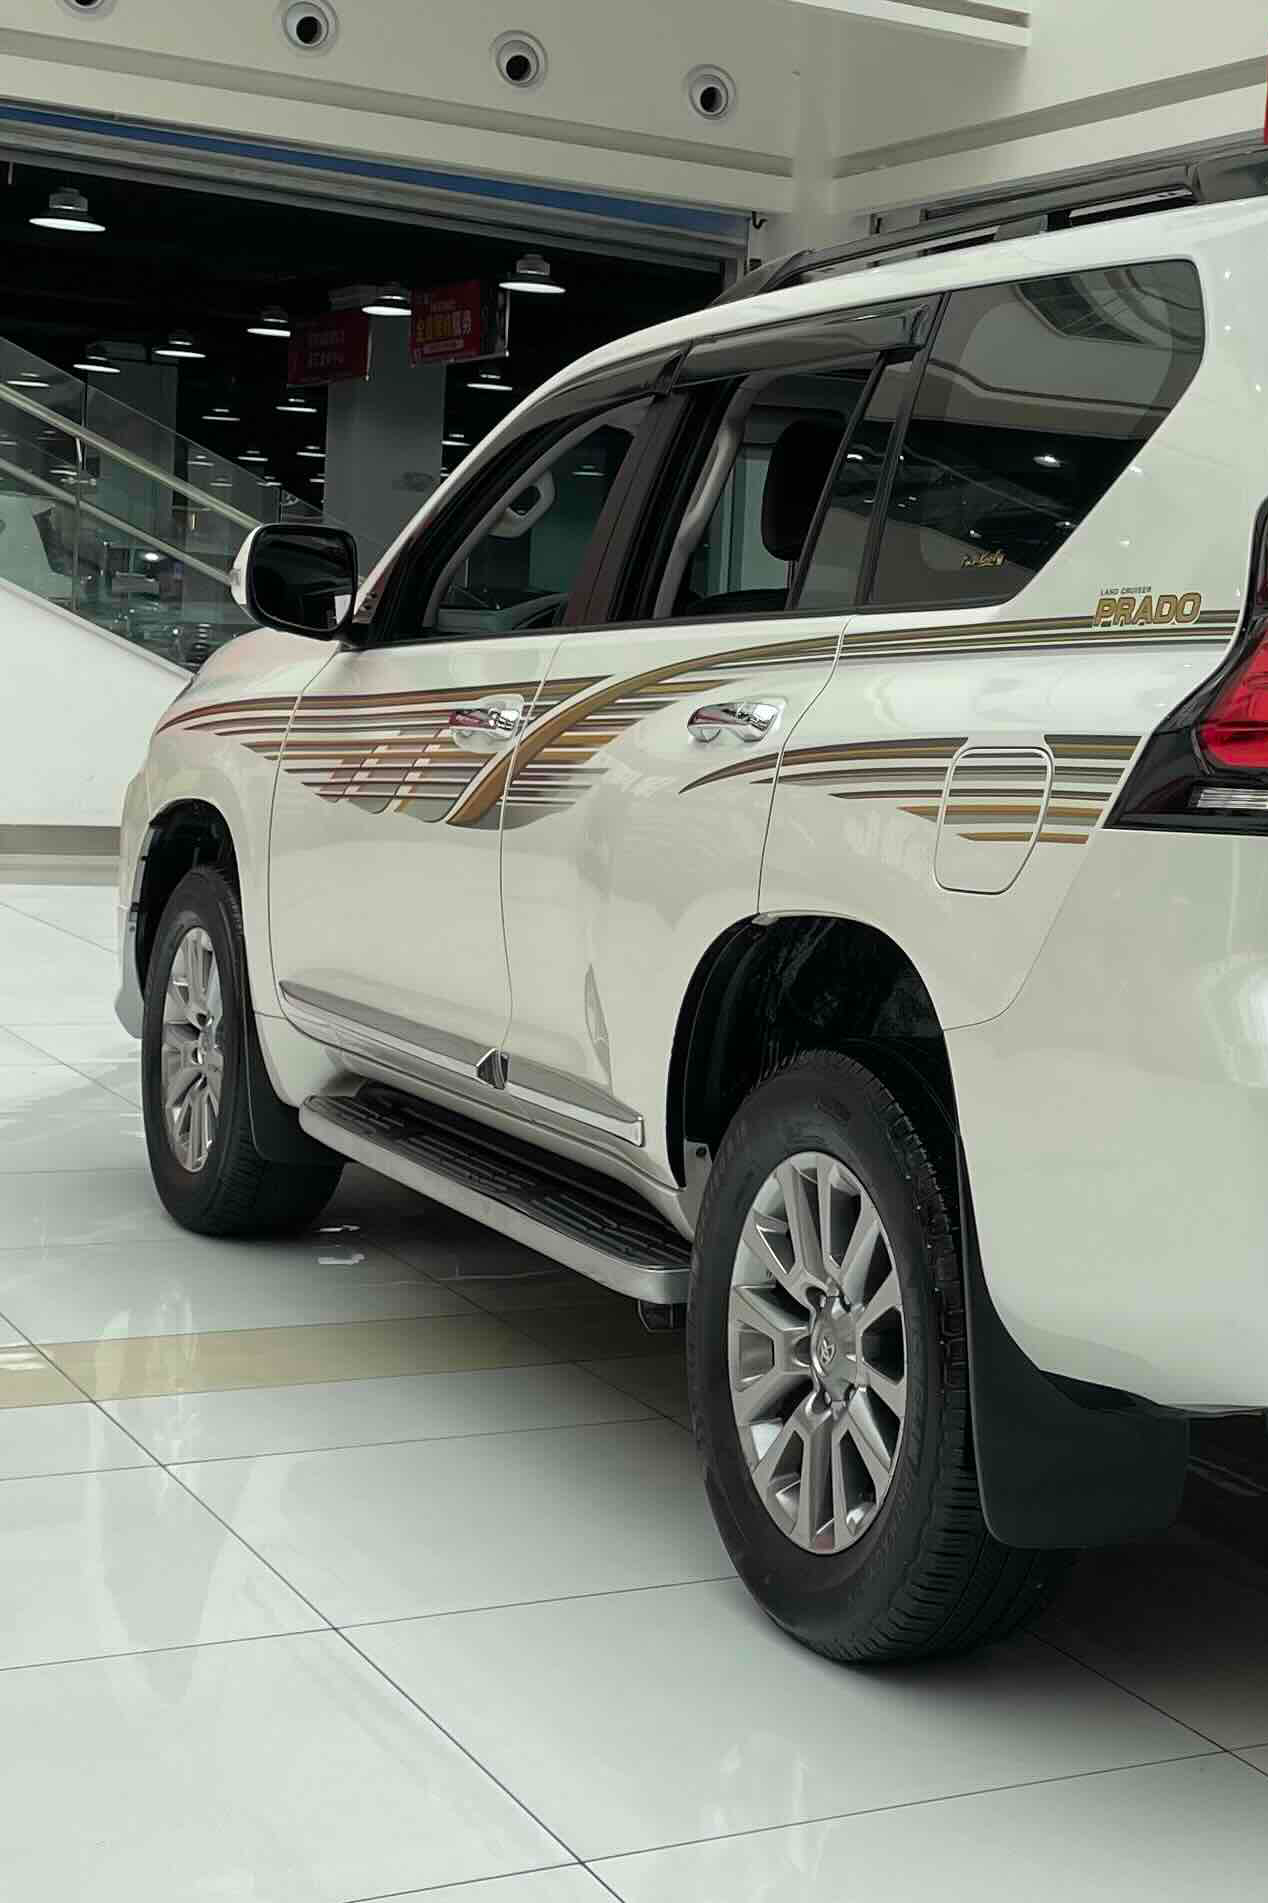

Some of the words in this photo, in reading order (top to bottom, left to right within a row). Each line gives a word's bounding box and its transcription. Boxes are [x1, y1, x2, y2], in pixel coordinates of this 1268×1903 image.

[1100, 588, 1119, 597] LAND
[1121, 586, 1152, 595] CRUISER
[1094, 592, 1202, 627] PRADO
